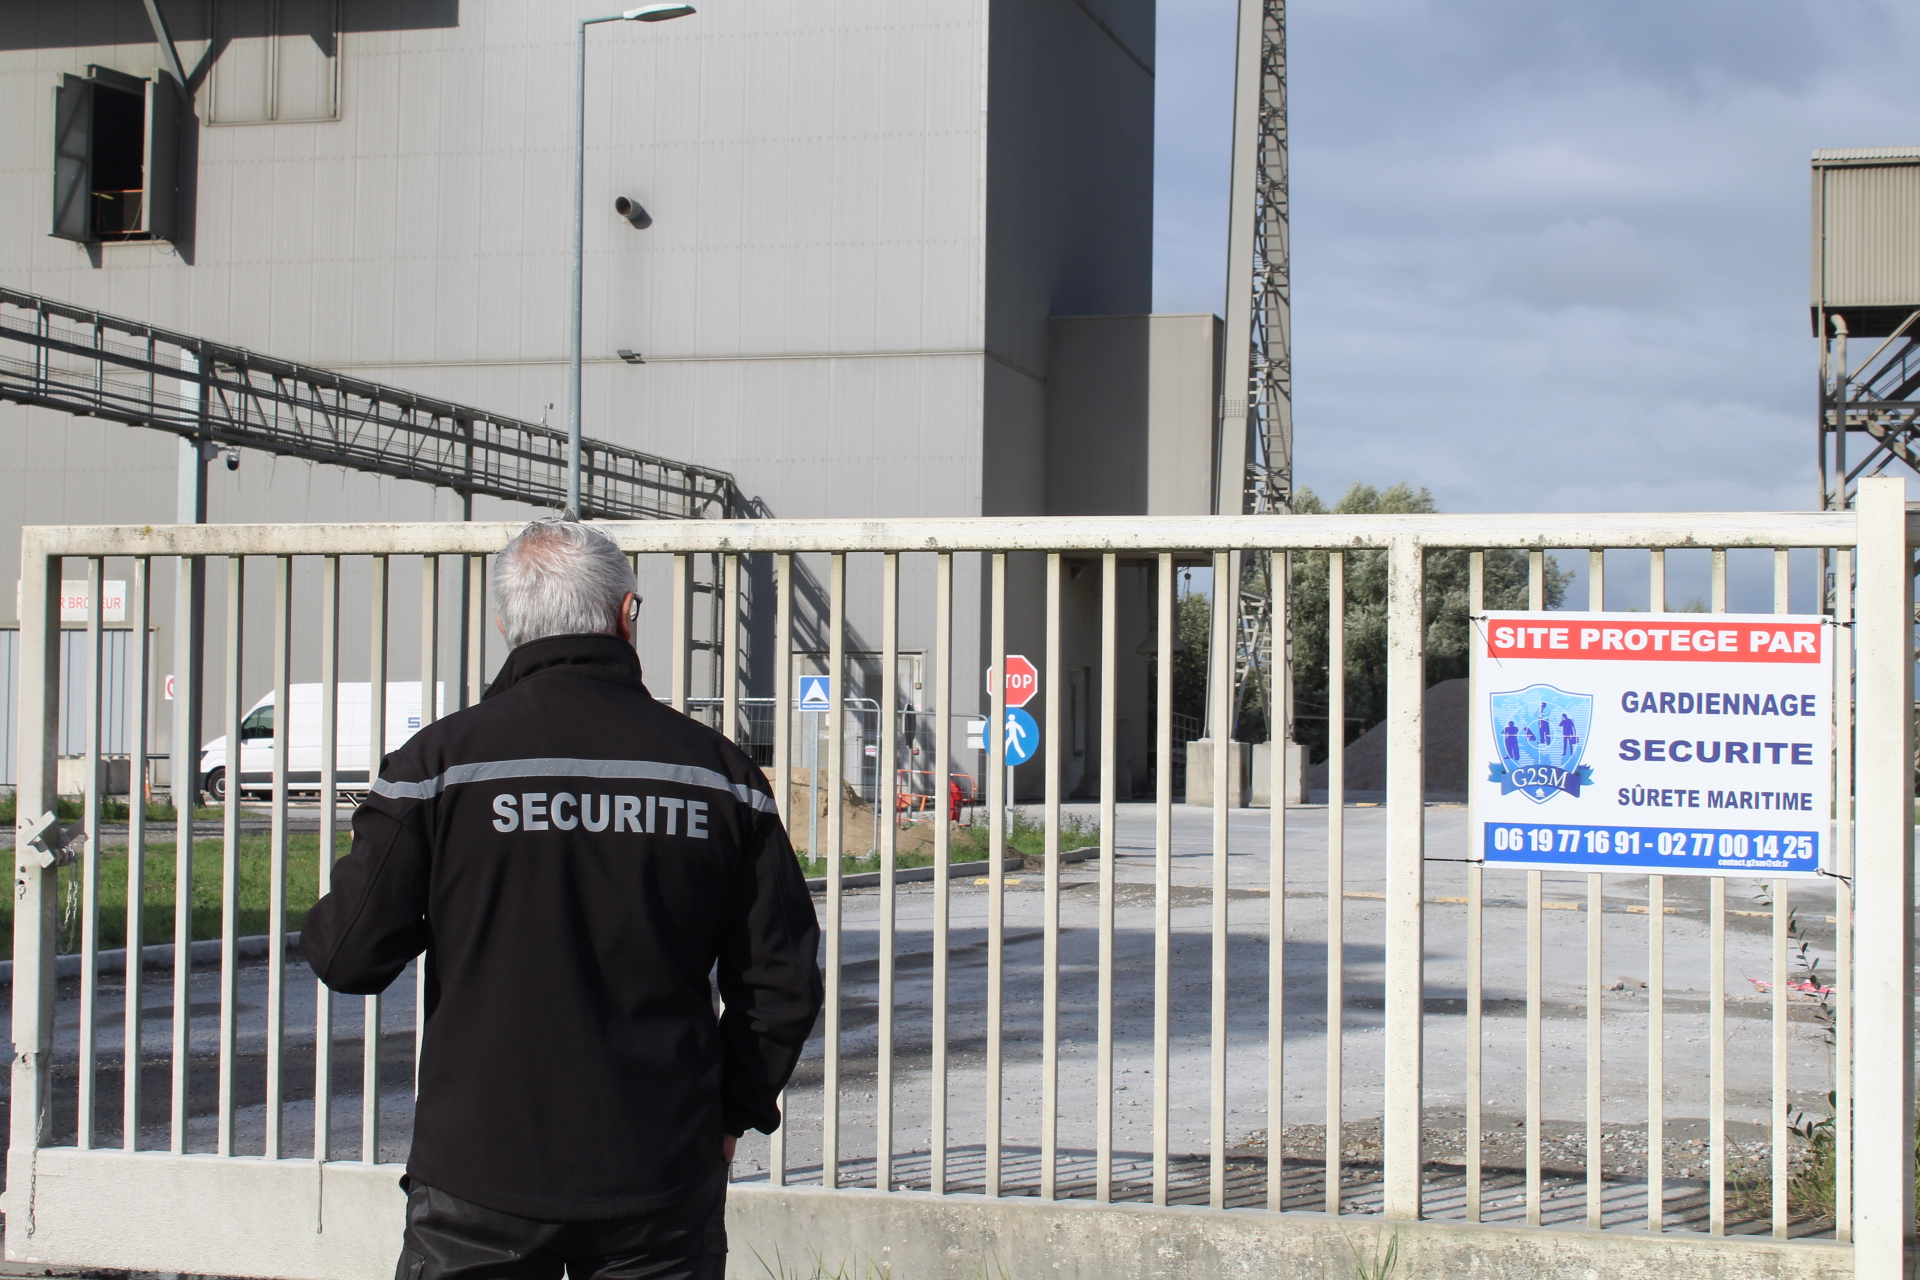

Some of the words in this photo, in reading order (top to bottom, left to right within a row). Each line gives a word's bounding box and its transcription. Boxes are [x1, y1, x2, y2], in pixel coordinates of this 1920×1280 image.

[1494, 626, 1569, 649] SITE
[1580, 628, 1738, 652] PROTEGE
[1750, 630, 1816, 653] PAR
[1005, 673, 1033, 689] TOP
[1621, 690, 1816, 717] GARDIENNAGE
[1618, 738, 1813, 765] SECURITE
[1511, 766, 1569, 789] G2SM
[1617, 783, 1700, 808] SÛRETE
[1707, 790, 1813, 811] MARITIME
[492, 792, 709, 839] SECURITE
[1494, 827, 1523, 851] 06
[1527, 828, 1553, 851] 19
[1557, 829, 1581, 852] 77
[1584, 830, 1609, 853] 16
[1614, 831, 1640, 854] 91
[1657, 832, 1686, 856] 02
[1690, 833, 1715, 856] 77
[1718, 833, 1748, 858] 00
[1753, 834, 1779, 858] 14
[1783, 835, 1813, 860] 25
